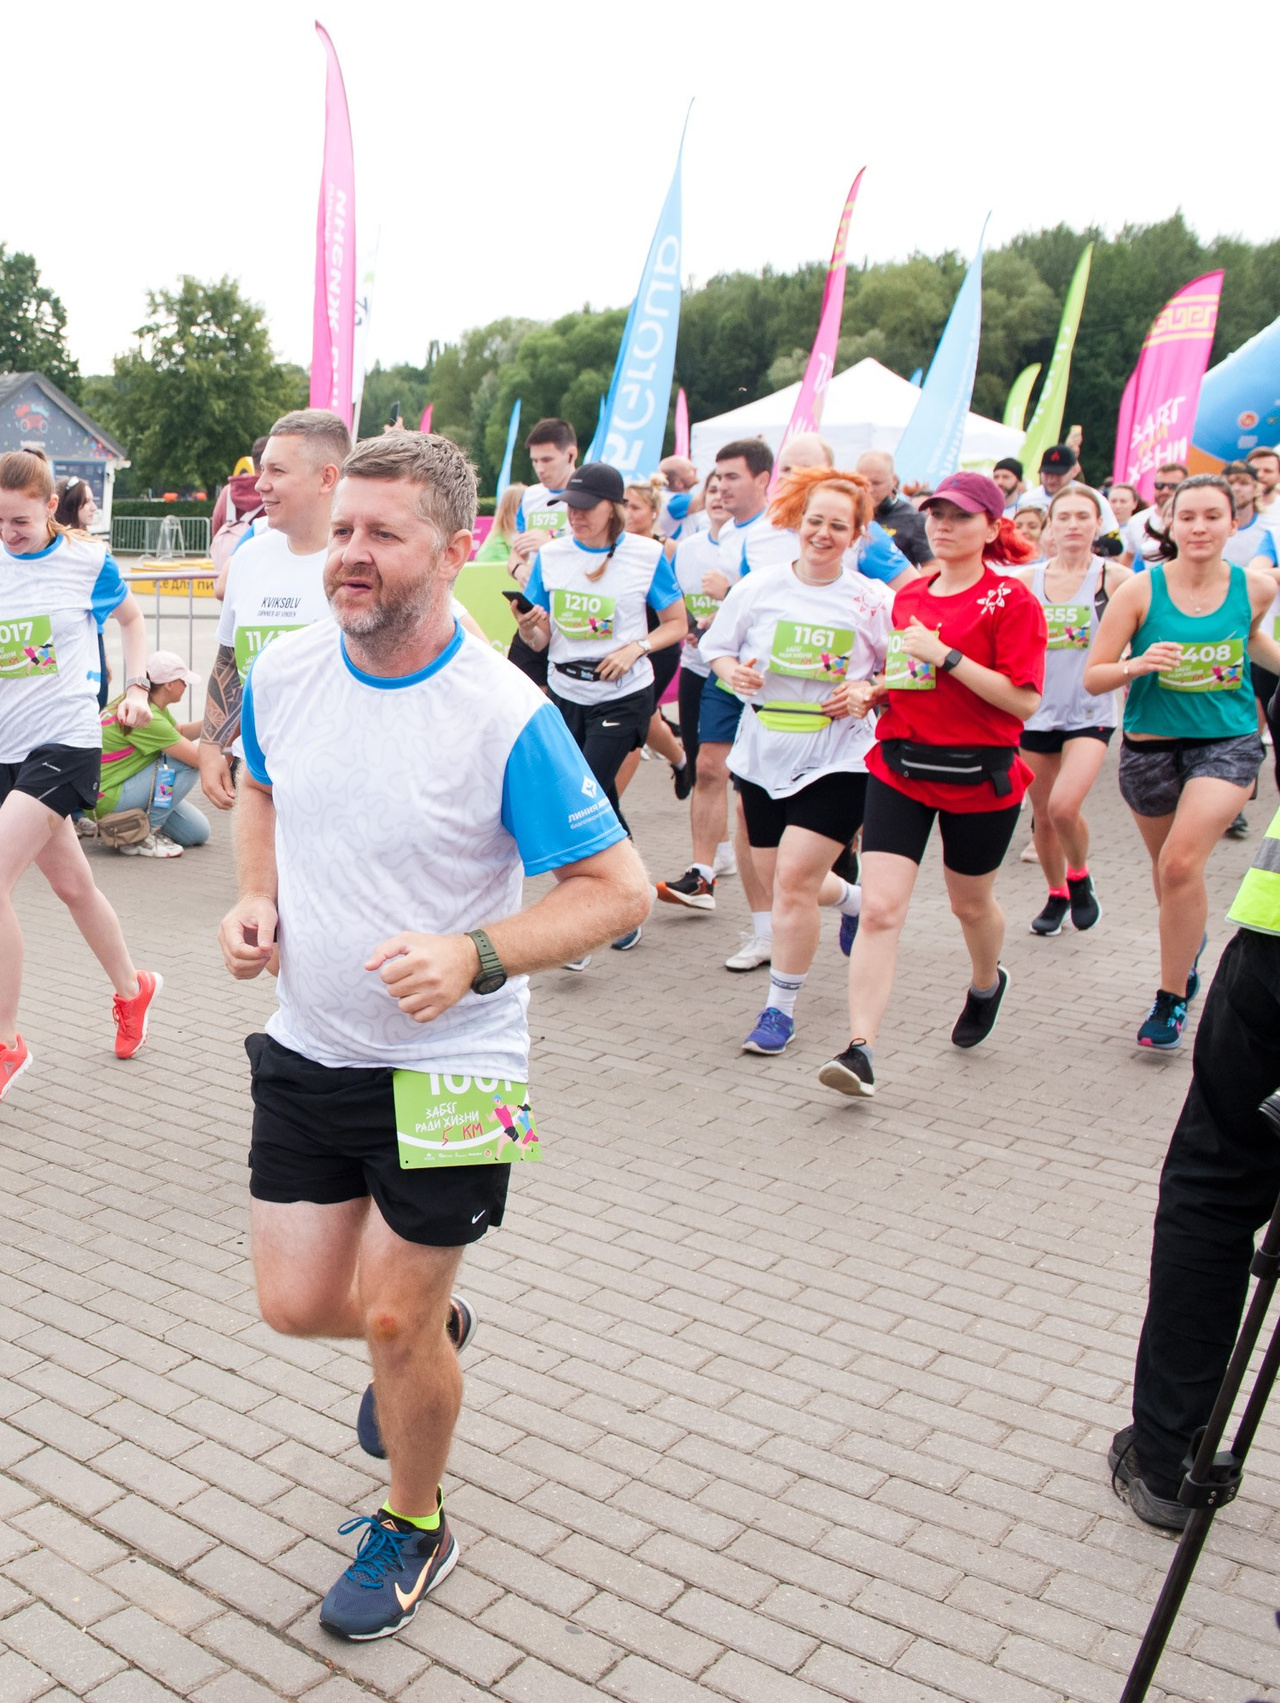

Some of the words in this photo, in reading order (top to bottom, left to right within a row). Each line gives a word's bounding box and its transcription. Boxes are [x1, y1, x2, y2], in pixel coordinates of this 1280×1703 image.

[531, 513, 558, 526] 1575
[261, 596, 302, 609] KVIKSØLV
[564, 593, 602, 613] 1210
[245, 630, 287, 652] 11
[794, 626, 835, 648] 1161
[1175, 645, 1231, 663] 408
[568, 803, 600, 823] ЛИНИЯ
[426, 1101, 458, 1119] ЗАБЕГ
[415, 1117, 441, 1133] РАДИ
[443, 1110, 480, 1128] ЖИЗНИ
[442, 1126, 453, 1147] 5
[462, 1122, 484, 1140] КМ
